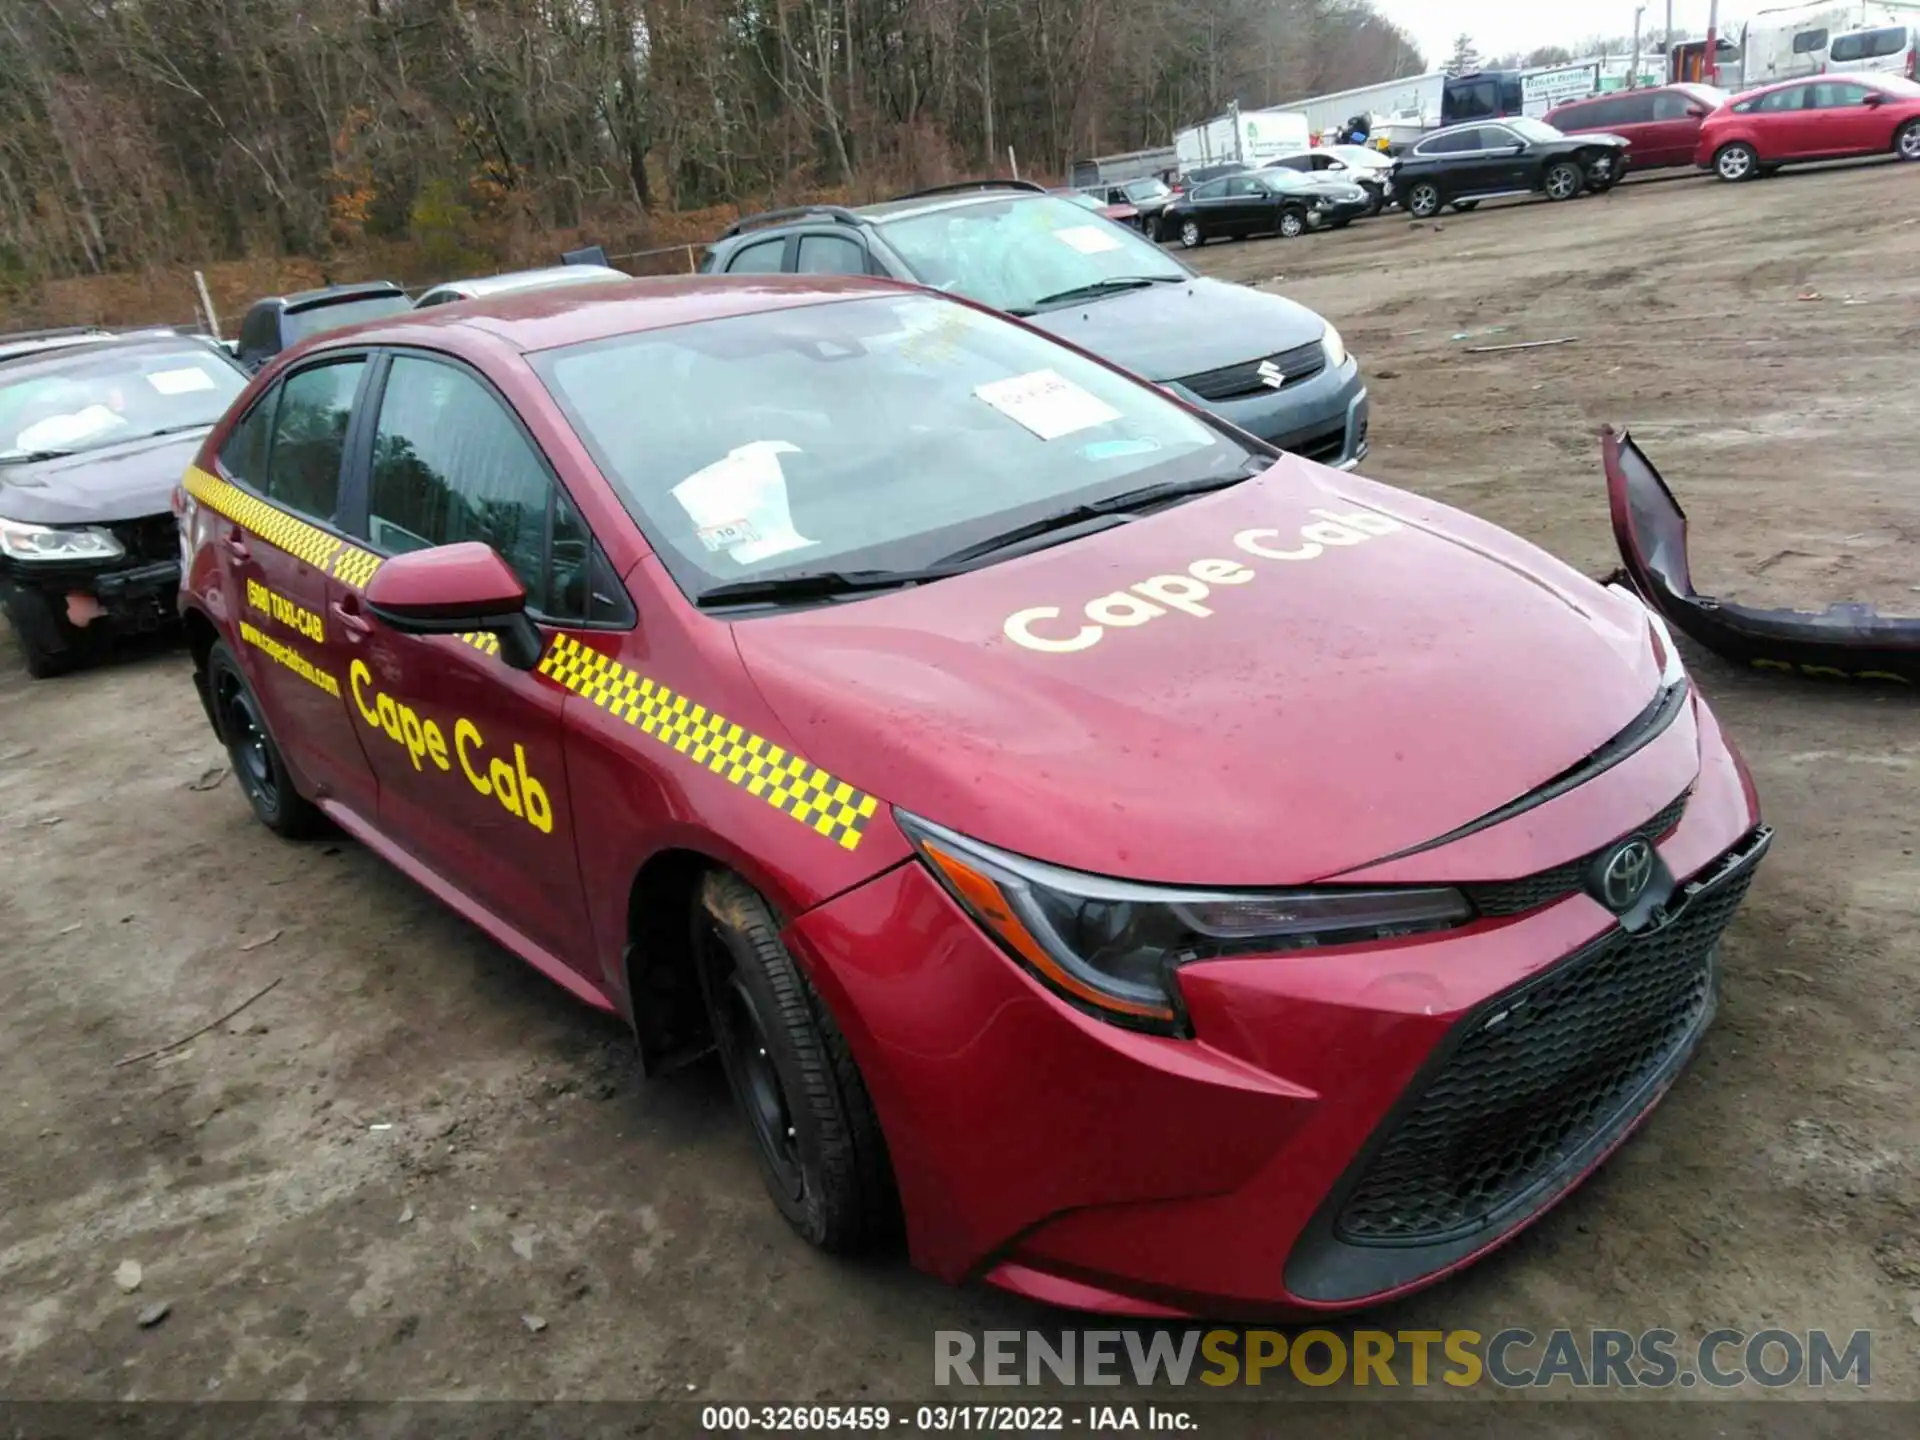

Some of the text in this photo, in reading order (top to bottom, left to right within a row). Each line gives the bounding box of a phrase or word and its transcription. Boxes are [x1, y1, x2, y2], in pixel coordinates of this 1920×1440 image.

[270, 591, 324, 643] TAXI-CAB
[1003, 508, 1401, 652] Cape Cab
[351, 659, 552, 833] Cape Cab
